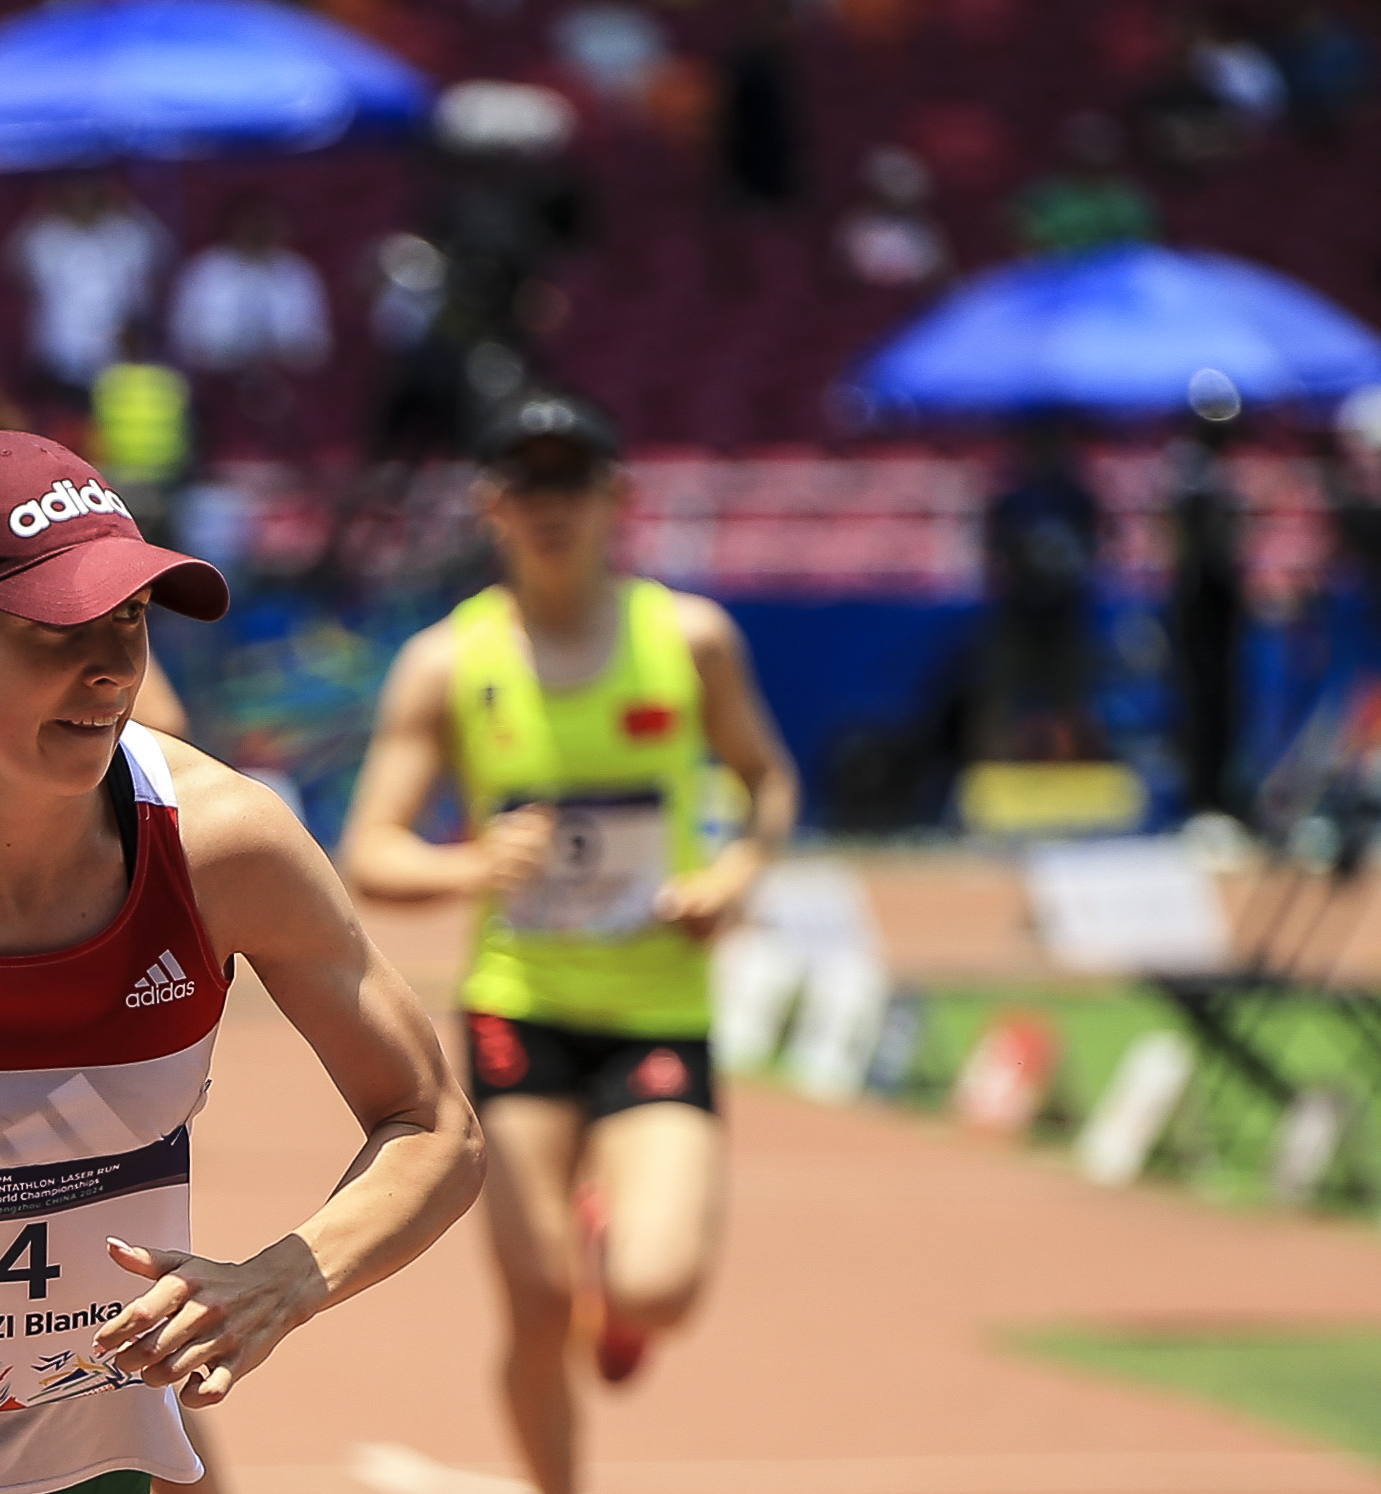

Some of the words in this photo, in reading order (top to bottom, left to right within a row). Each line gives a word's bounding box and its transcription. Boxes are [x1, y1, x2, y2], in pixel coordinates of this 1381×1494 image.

[9, 478, 133, 538] adida
[125, 979, 195, 1008] adidas
[61, 1170, 94, 1184] LASER
[97, 1163, 120, 1175] RUN
[20, 1178, 100, 1200] Championships
[25, 1301, 123, 1337] Blanka
